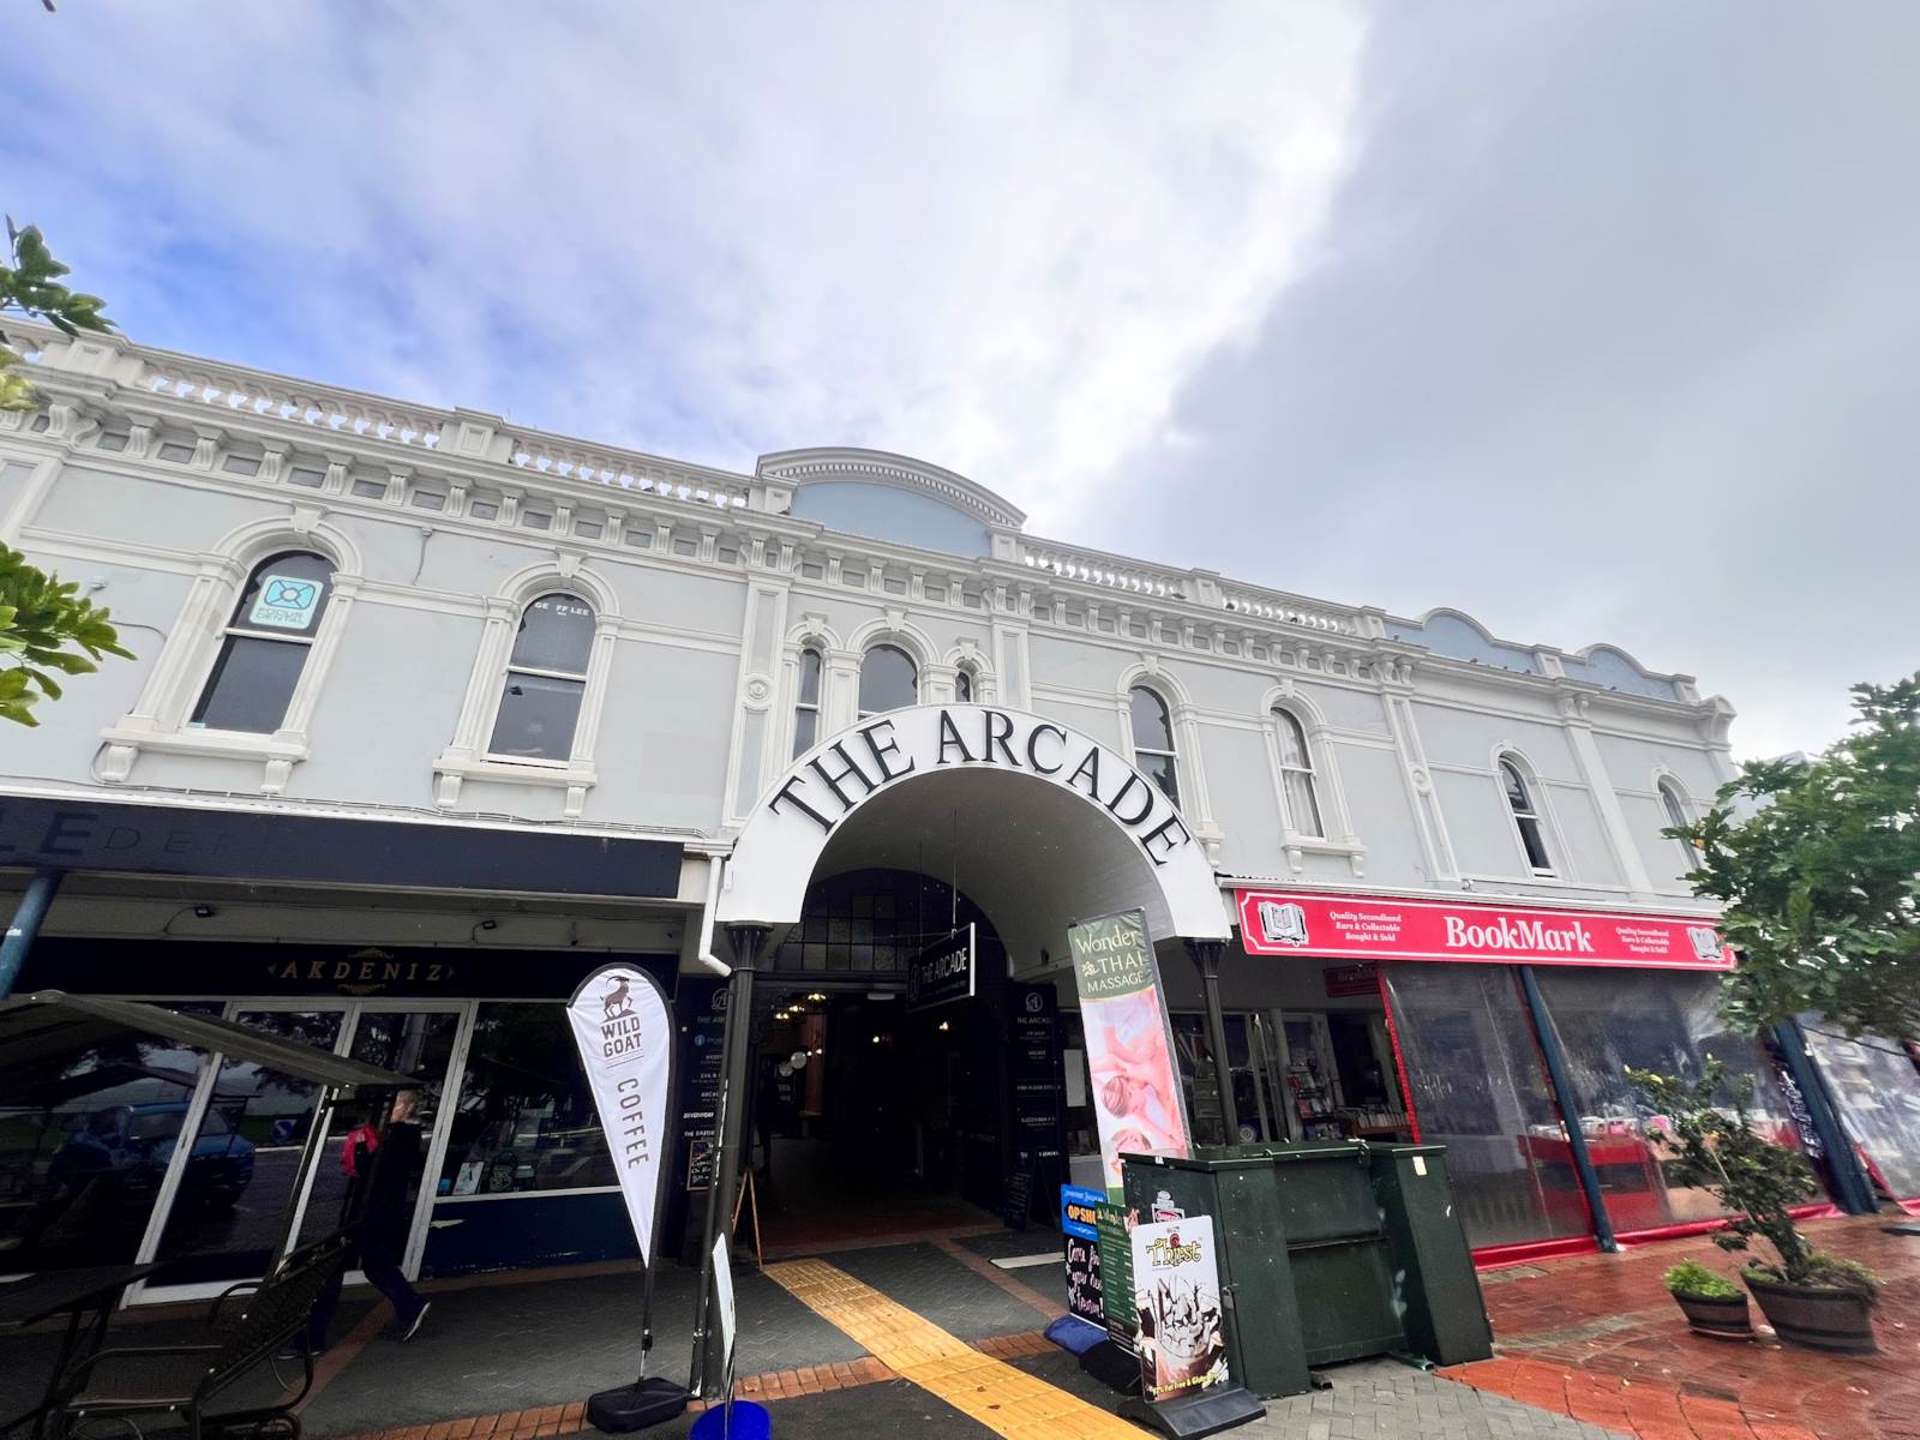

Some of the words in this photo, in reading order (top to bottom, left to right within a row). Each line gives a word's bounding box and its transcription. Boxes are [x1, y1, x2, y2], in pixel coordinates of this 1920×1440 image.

[768, 718, 917, 835] THE
[936, 709, 1192, 866] ARCADE
[1329, 911, 1357, 921] Quality
[1358, 913, 1402, 922] Secondhand
[1336, 921, 1354, 929] Rare
[1355, 922, 1361, 930] &
[1076, 924, 1138, 954] Wonder
[1345, 932, 1372, 942] Bought
[1444, 915, 1596, 953] BookMark
[280, 961, 445, 982] AKDENIZ
[934, 946, 968, 980] ARCADE
[1098, 951, 1144, 975] THAI
[1088, 971, 1144, 993] MASSAGE
[600, 1017, 641, 1041] WILD
[603, 1033, 643, 1058] GOAT
[617, 1078, 649, 1169] COFFEE
